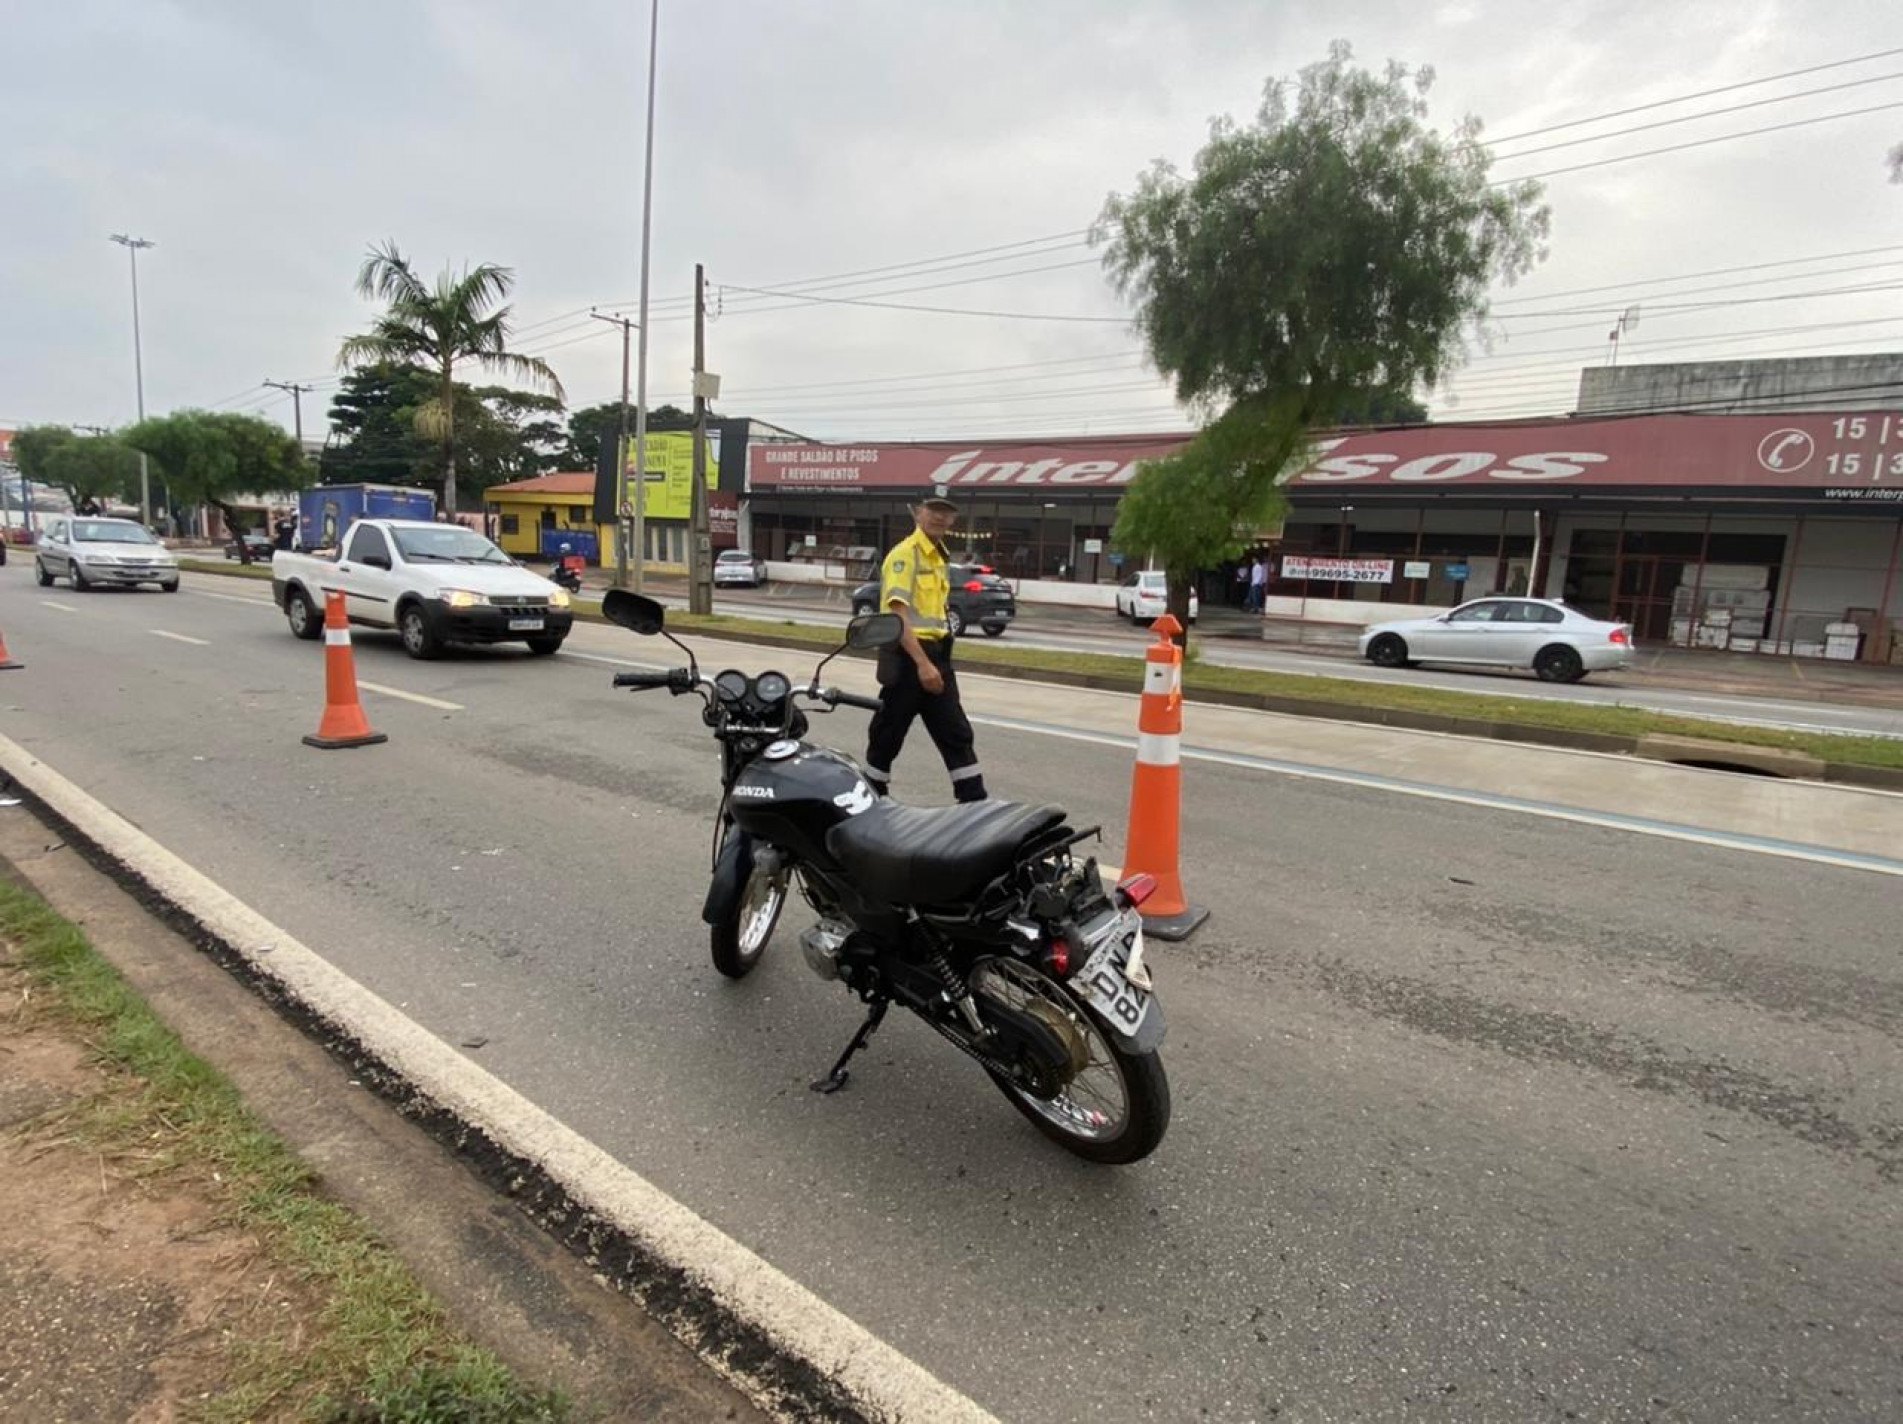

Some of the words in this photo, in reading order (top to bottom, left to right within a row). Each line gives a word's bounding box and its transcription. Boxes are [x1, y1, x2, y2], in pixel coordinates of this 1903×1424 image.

[1833, 417, 1866, 439] 15
[766, 451, 798, 462] GRANDE
[800, 448, 833, 462] SALDÃO
[836, 450, 847, 462] DE
[849, 449, 878, 462] PISOS
[930, 438, 1609, 485] interisos
[1826, 453, 1860, 474] 15
[788, 467, 860, 480] REVESTIMENTOS
